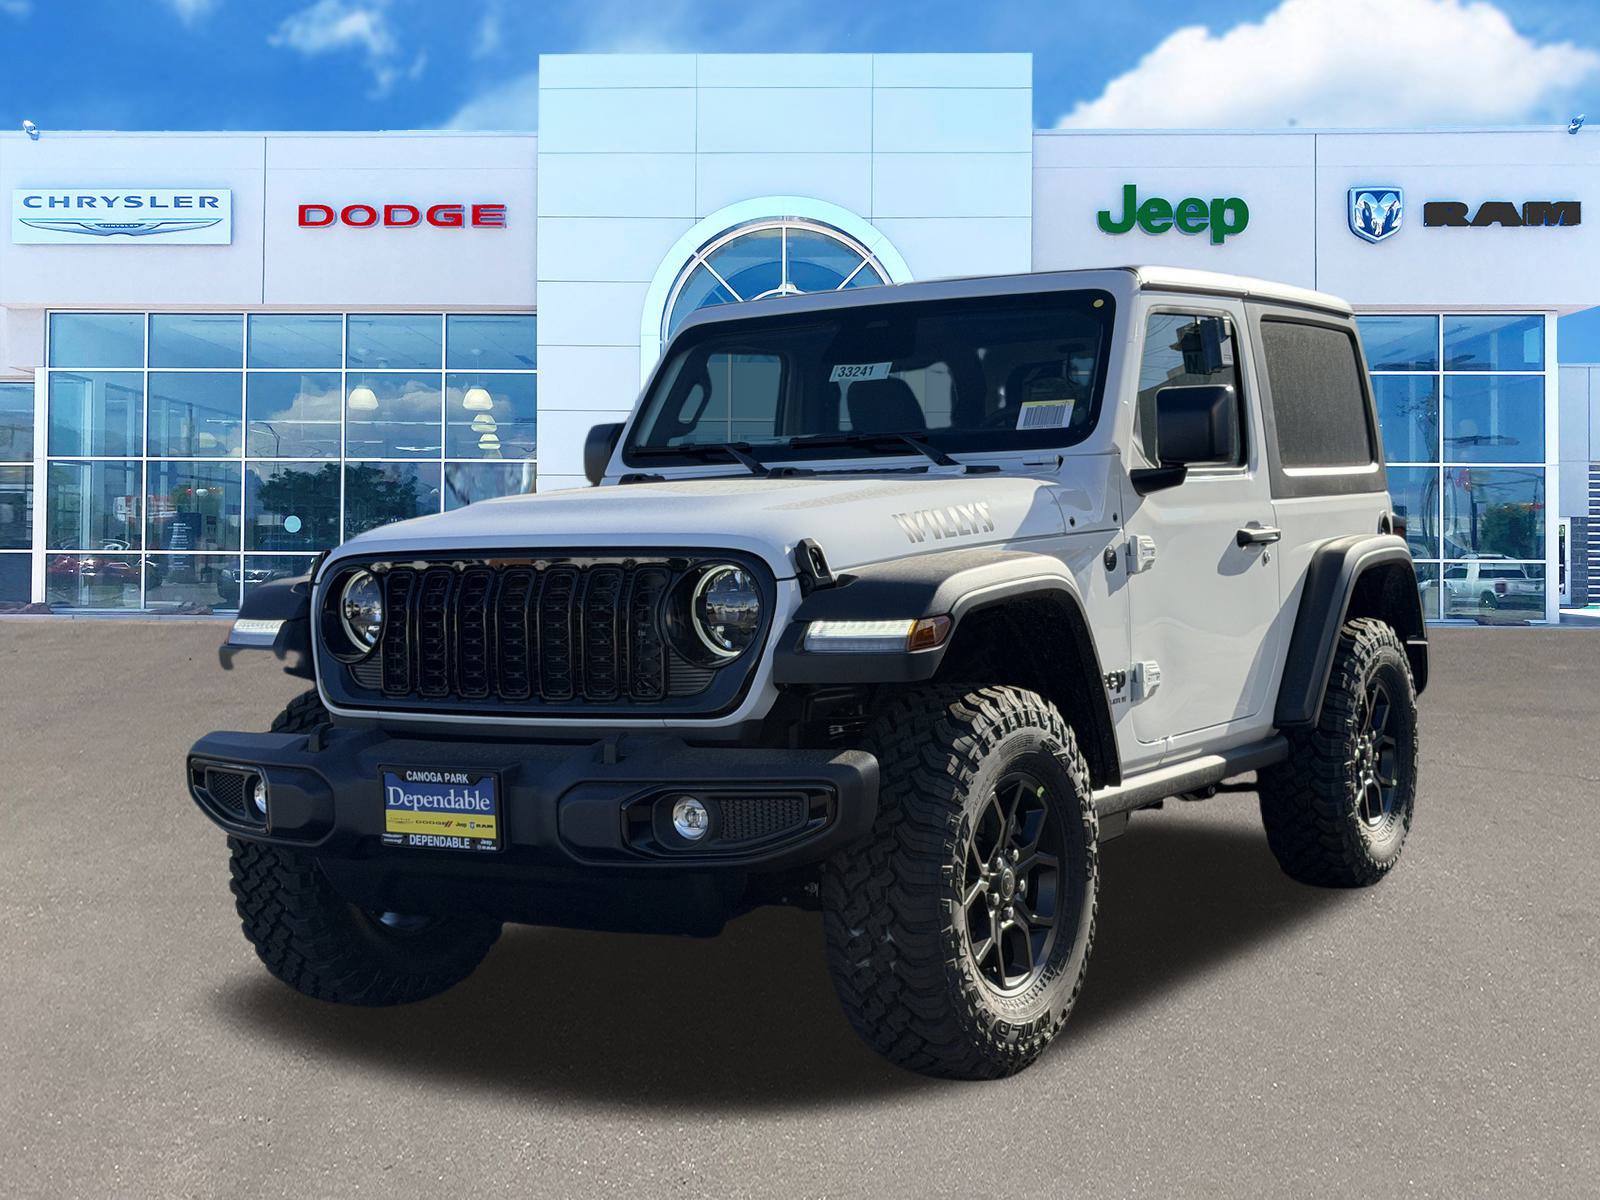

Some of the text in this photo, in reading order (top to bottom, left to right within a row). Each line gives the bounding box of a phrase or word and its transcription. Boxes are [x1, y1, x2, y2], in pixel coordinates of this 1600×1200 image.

[23, 195, 220, 209] CHRYSLER
[1097, 184, 1249, 245] Jeep
[1423, 201, 1582, 227] RAM
[298, 204, 507, 229] DODGE
[838, 366, 874, 378] 33241
[891, 501, 995, 544] WILLYS
[406, 770, 469, 784] CANOGA PARK
[387, 786, 490, 811] Dependable
[409, 834, 470, 849] DEPENDABLE
